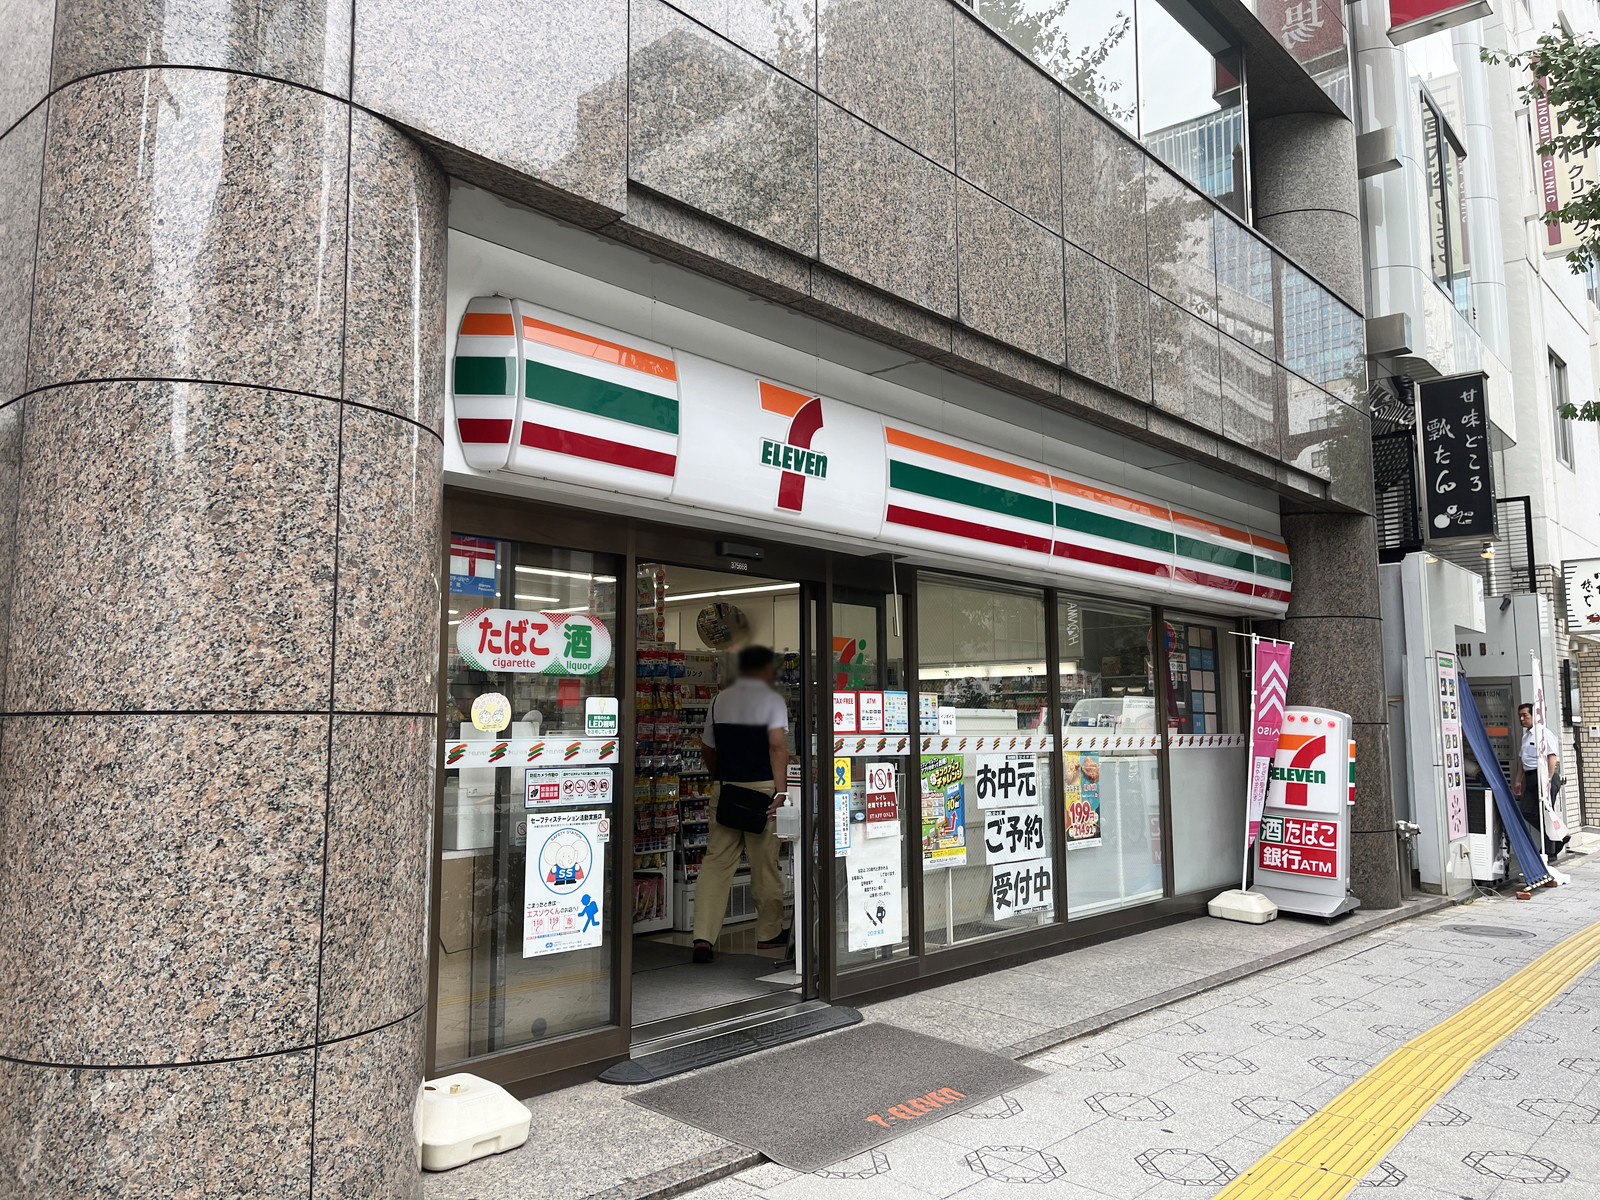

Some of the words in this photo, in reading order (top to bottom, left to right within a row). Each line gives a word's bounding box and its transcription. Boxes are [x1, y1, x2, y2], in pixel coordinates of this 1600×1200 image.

[1542, 159, 1556, 203] CLINIC
[1460, 388, 1483, 493] 甘味どころ
[478, 617, 550, 656] たばこ
[563, 623, 592, 659] 酒
[492, 657, 536, 669] cigarette
[566, 660, 592, 671] liquor
[976, 761, 1037, 799] お中元
[986, 815, 1044, 853] ご予約
[1260, 817, 1284, 842] 酒
[1285, 820, 1336, 847] たばこ
[559, 868, 573, 878] SS
[1263, 847, 1332, 873] 銀行ATM
[993, 866, 1051, 909] 受付中
